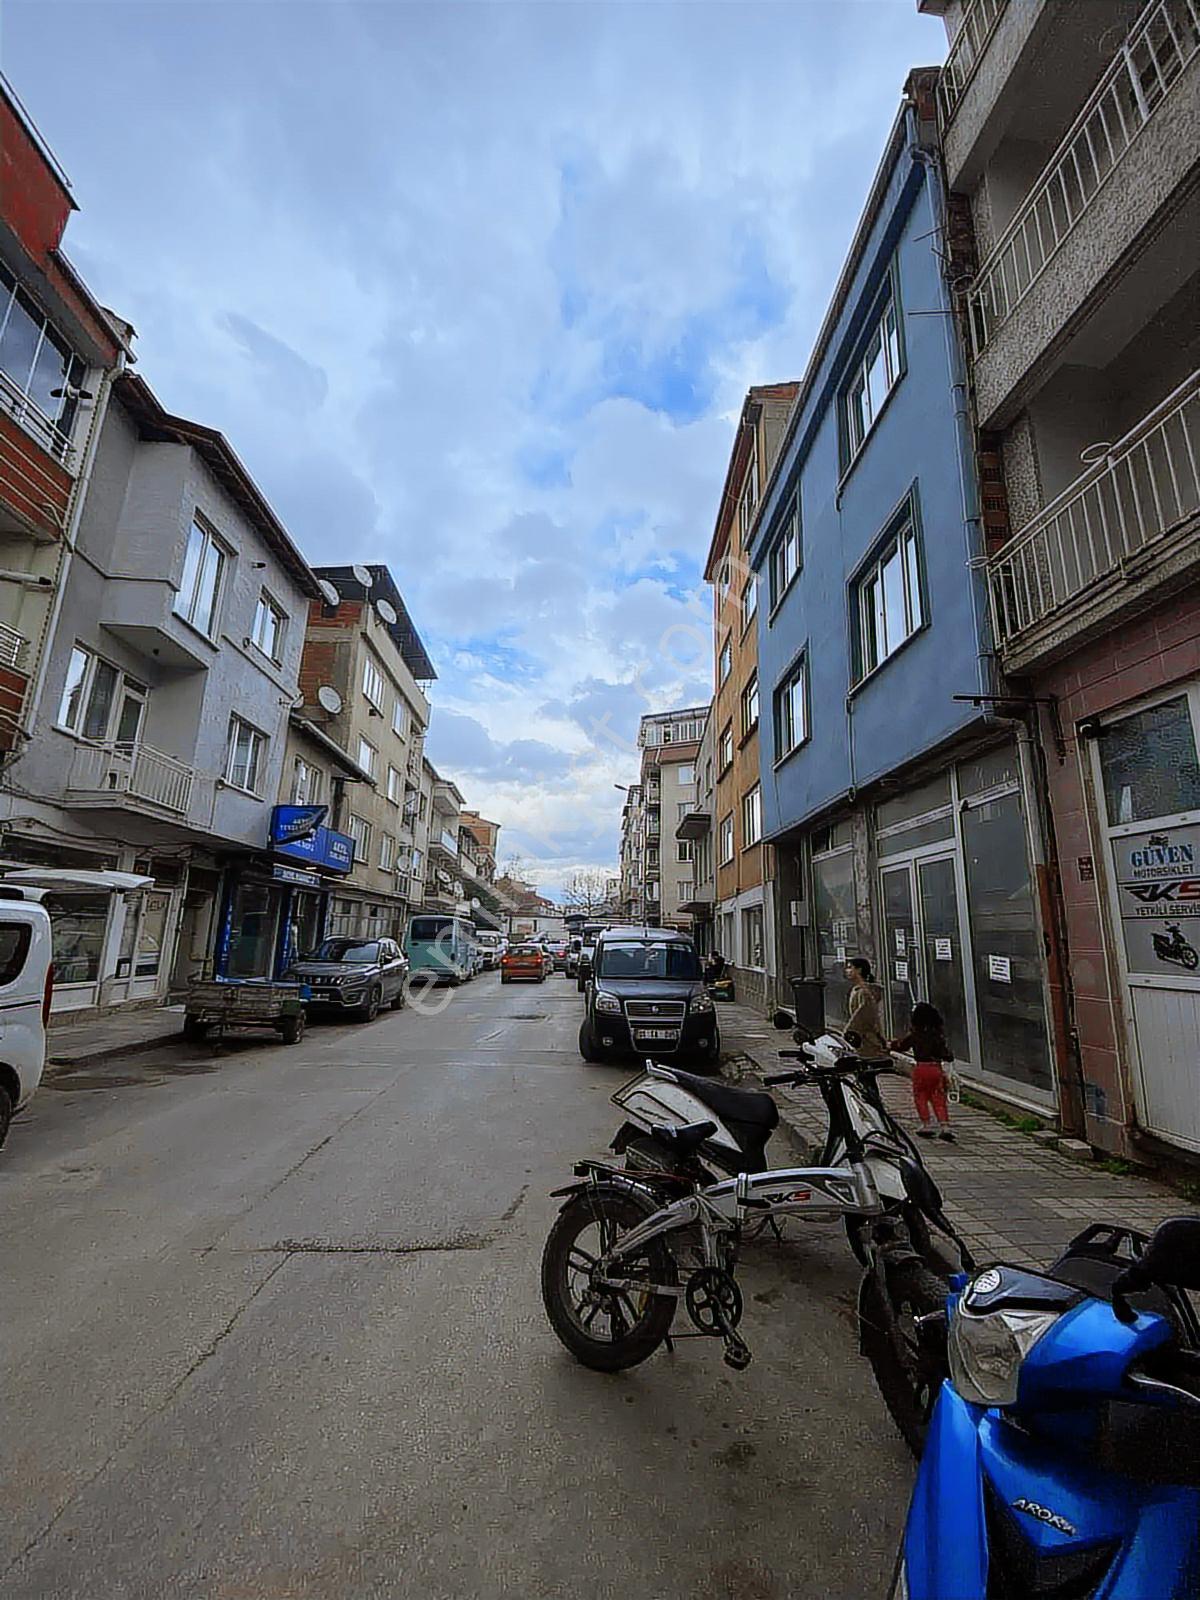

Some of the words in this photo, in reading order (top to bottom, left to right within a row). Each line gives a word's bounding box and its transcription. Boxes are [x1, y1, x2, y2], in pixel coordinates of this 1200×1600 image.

[1131, 844, 1194, 868] GÜVEN
[1124, 881, 1200, 902] RKS
[762, 1190, 812, 1204] RKS
